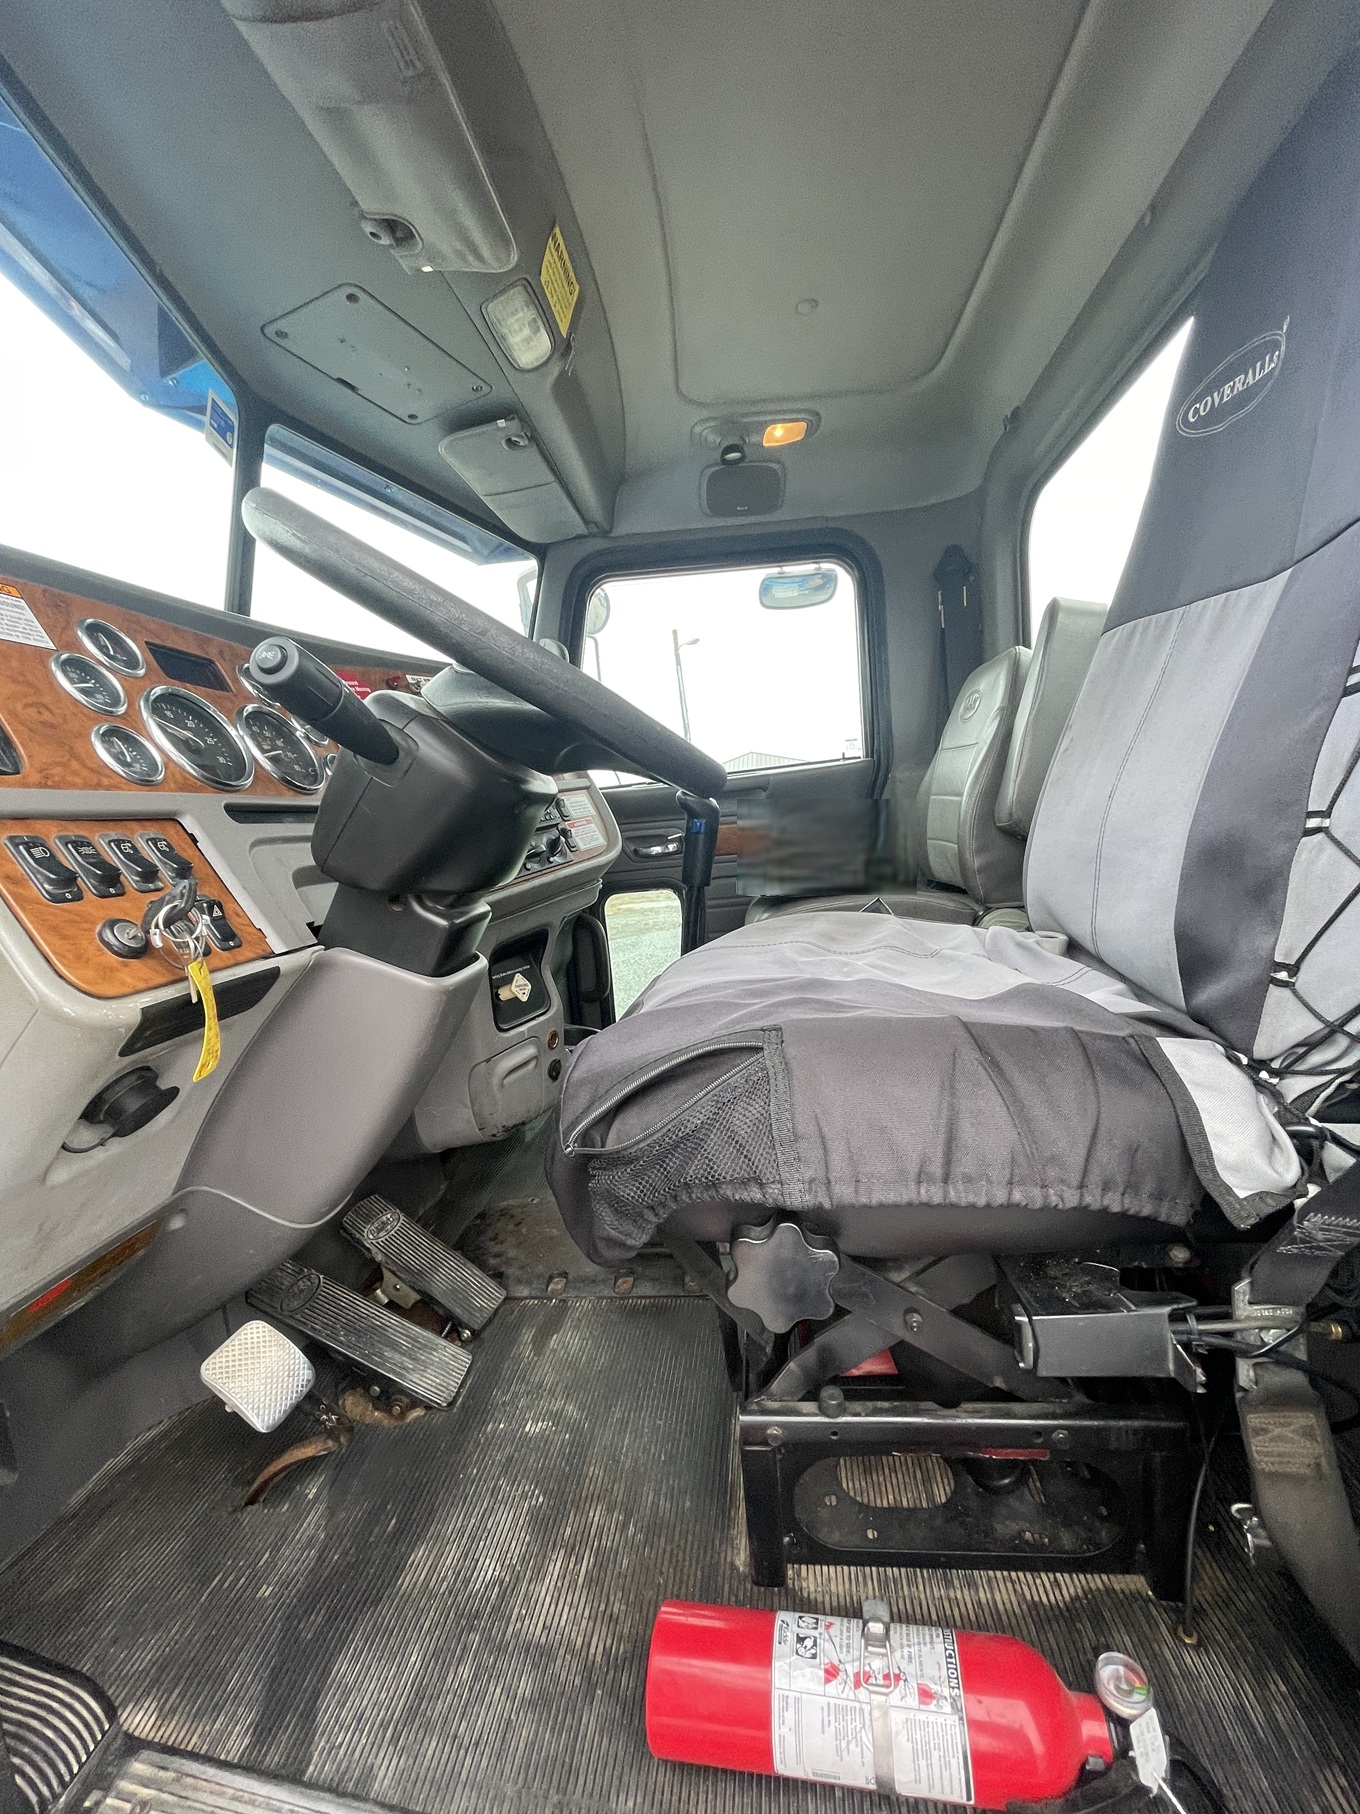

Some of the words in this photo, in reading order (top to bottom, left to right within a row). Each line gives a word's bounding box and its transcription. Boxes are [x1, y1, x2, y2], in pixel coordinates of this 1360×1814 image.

[550, 230, 577, 296] WARNING
[1187, 350, 1280, 423] COVERALLS
[185, 719, 196, 728] 20
[943, 1627, 960, 1697] STRUCTIONS
